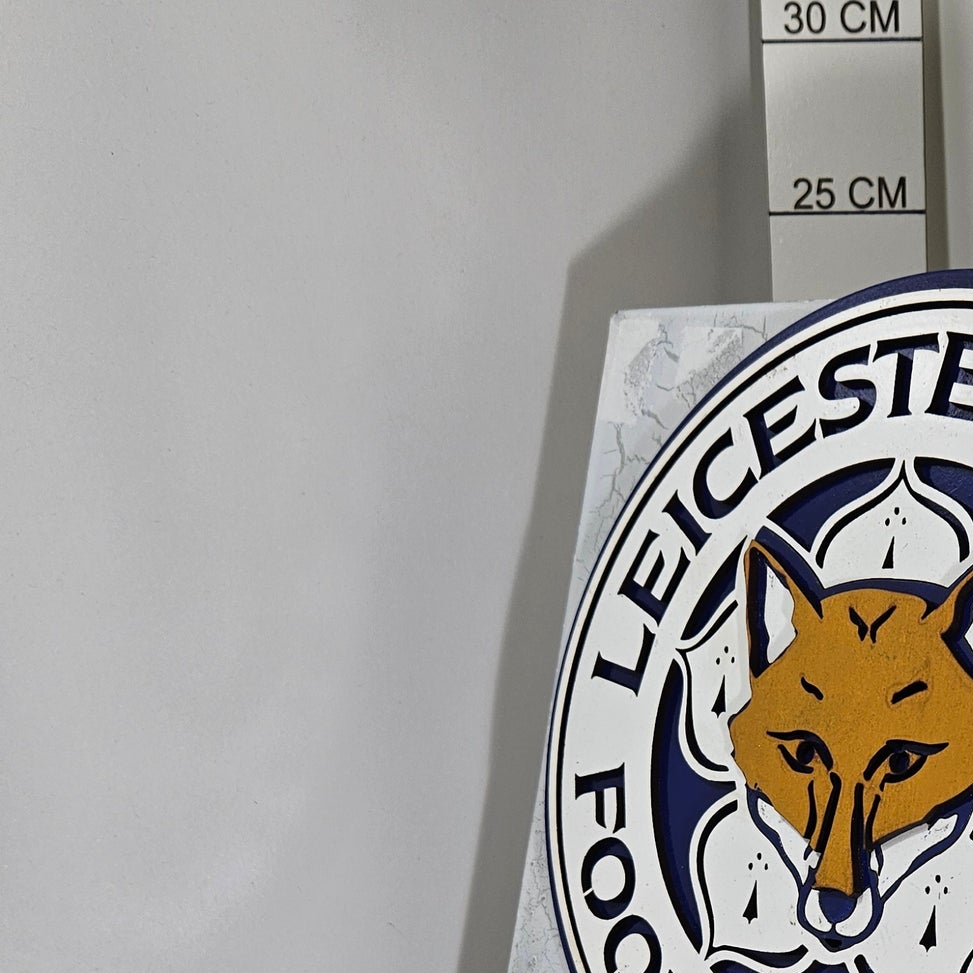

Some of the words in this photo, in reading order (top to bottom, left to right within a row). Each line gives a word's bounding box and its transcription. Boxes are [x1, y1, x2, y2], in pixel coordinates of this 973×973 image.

[784, 0, 827, 34] 30
[840, 0, 900, 33] CM
[793, 177, 836, 210] 25
[849, 176, 907, 209] CM
